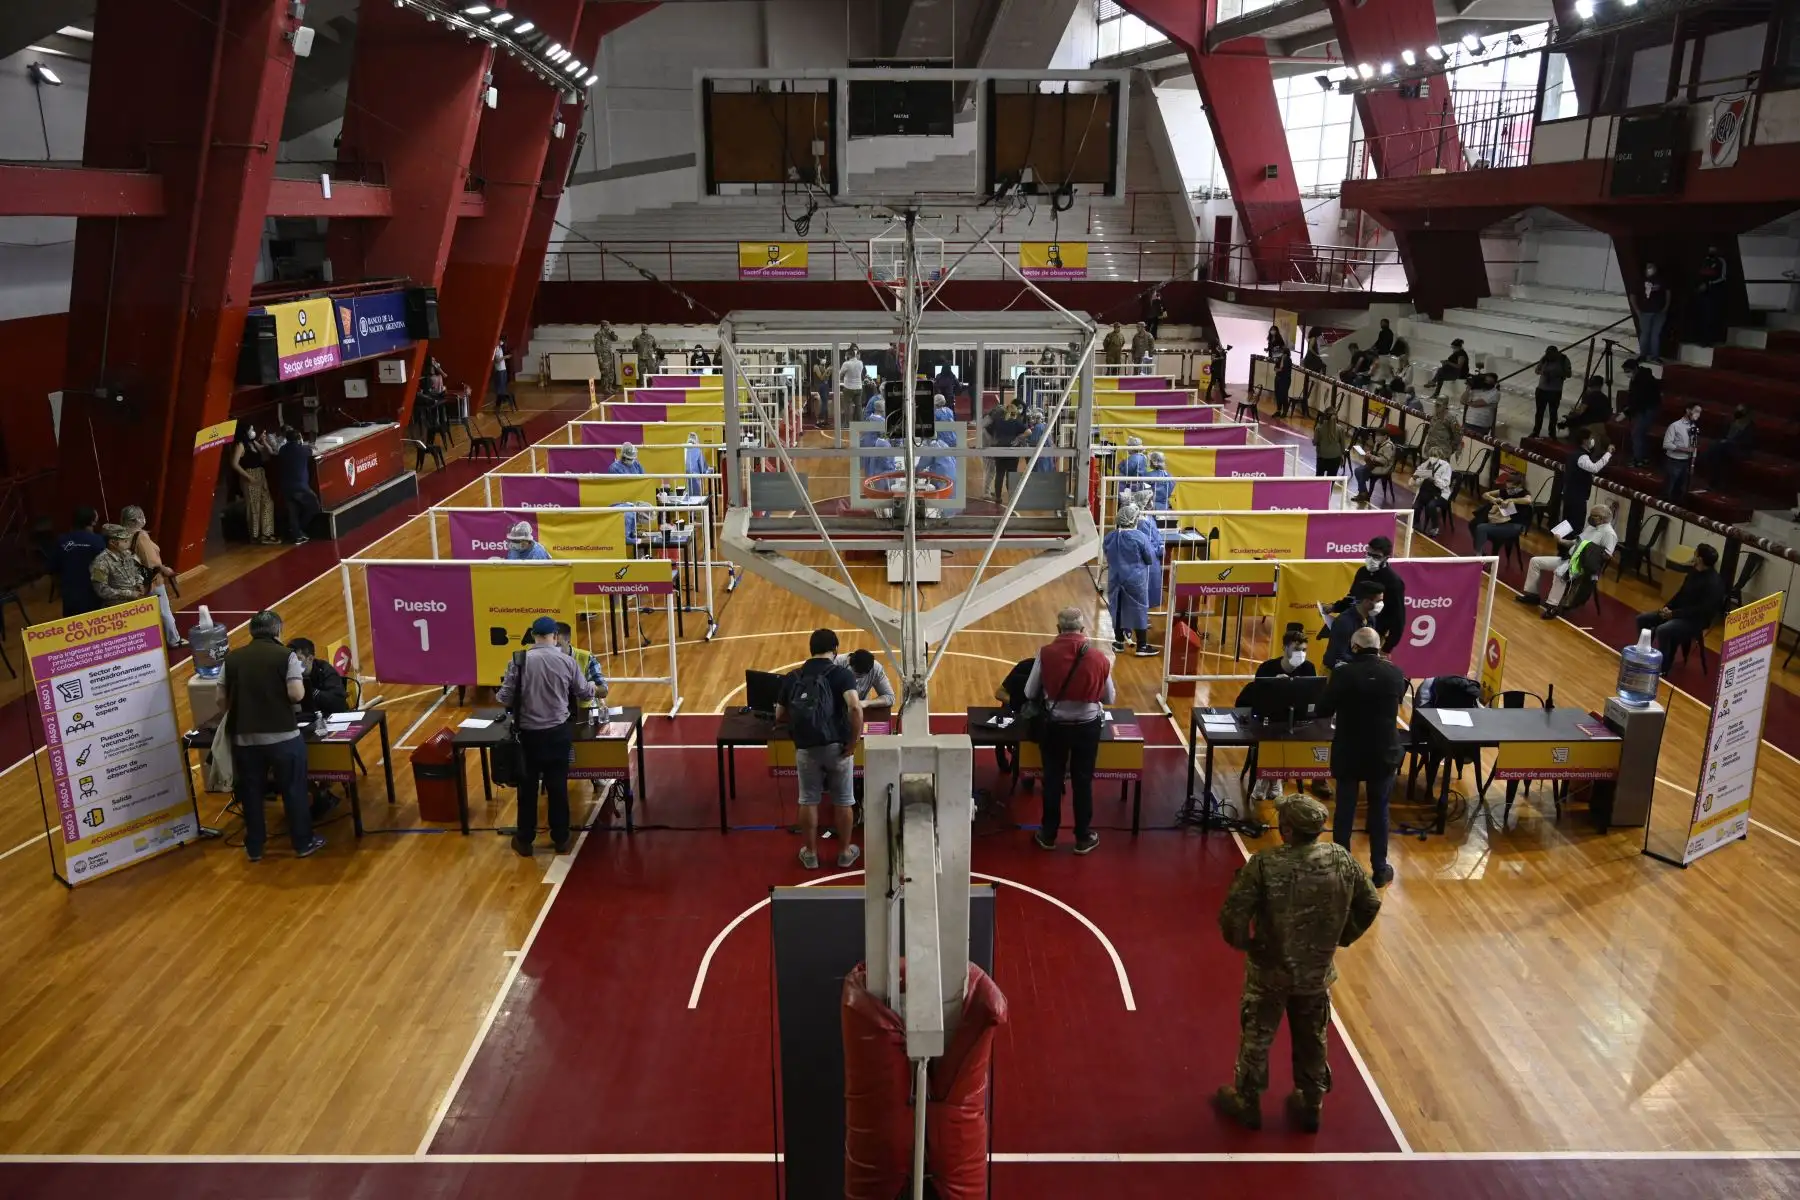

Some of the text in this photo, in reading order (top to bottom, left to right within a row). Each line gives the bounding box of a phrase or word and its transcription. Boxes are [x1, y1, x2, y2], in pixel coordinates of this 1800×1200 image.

[368, 317, 381, 327] BANCO
[385, 321, 406, 331] ARGENTINA
[283, 352, 334, 374] Sector de espera
[598, 584, 649, 594] Vacunación
[1199, 585, 1250, 595] Vacunación
[394, 599, 447, 612] Puesto
[1404, 596, 1453, 609] Puesto
[27, 601, 153, 642] Posta de vacunación
[64, 618, 127, 643] COVID-19:
[1409, 614, 1437, 647] 9
[413, 618, 430, 652] 1
[47, 652, 63, 661] Para
[64, 645, 91, 658] ingresar
[100, 635, 127, 648] requiere
[51, 655, 75, 667] previo,
[76, 650, 93, 660] toma
[104, 637, 143, 653] temperatura
[56, 656, 92, 671] colocación
[103, 647, 126, 658] alcohol
[88, 666, 111, 678] Sector
[89, 662, 151, 684] empadronamiento
[41, 688, 52, 710] PASO
[94, 696, 126, 711] Sector de
[95, 705, 118, 717] espera
[47, 722, 58, 744] PASO
[99, 727, 133, 742] Puesto de
[100, 731, 139, 749] vacunación
[54, 755, 64, 776] PASO
[105, 759, 137, 774] Sector de
[106, 762, 147, 780] observación
[568, 770, 625, 778] adronamiento
[1500, 770, 1613, 779] Sector de empadronamiento
[1094, 771, 1138, 779] onamiento
[60, 788, 70, 808] PASO
[111, 793, 132, 805] Salida
[66, 820, 76, 839] PASO
